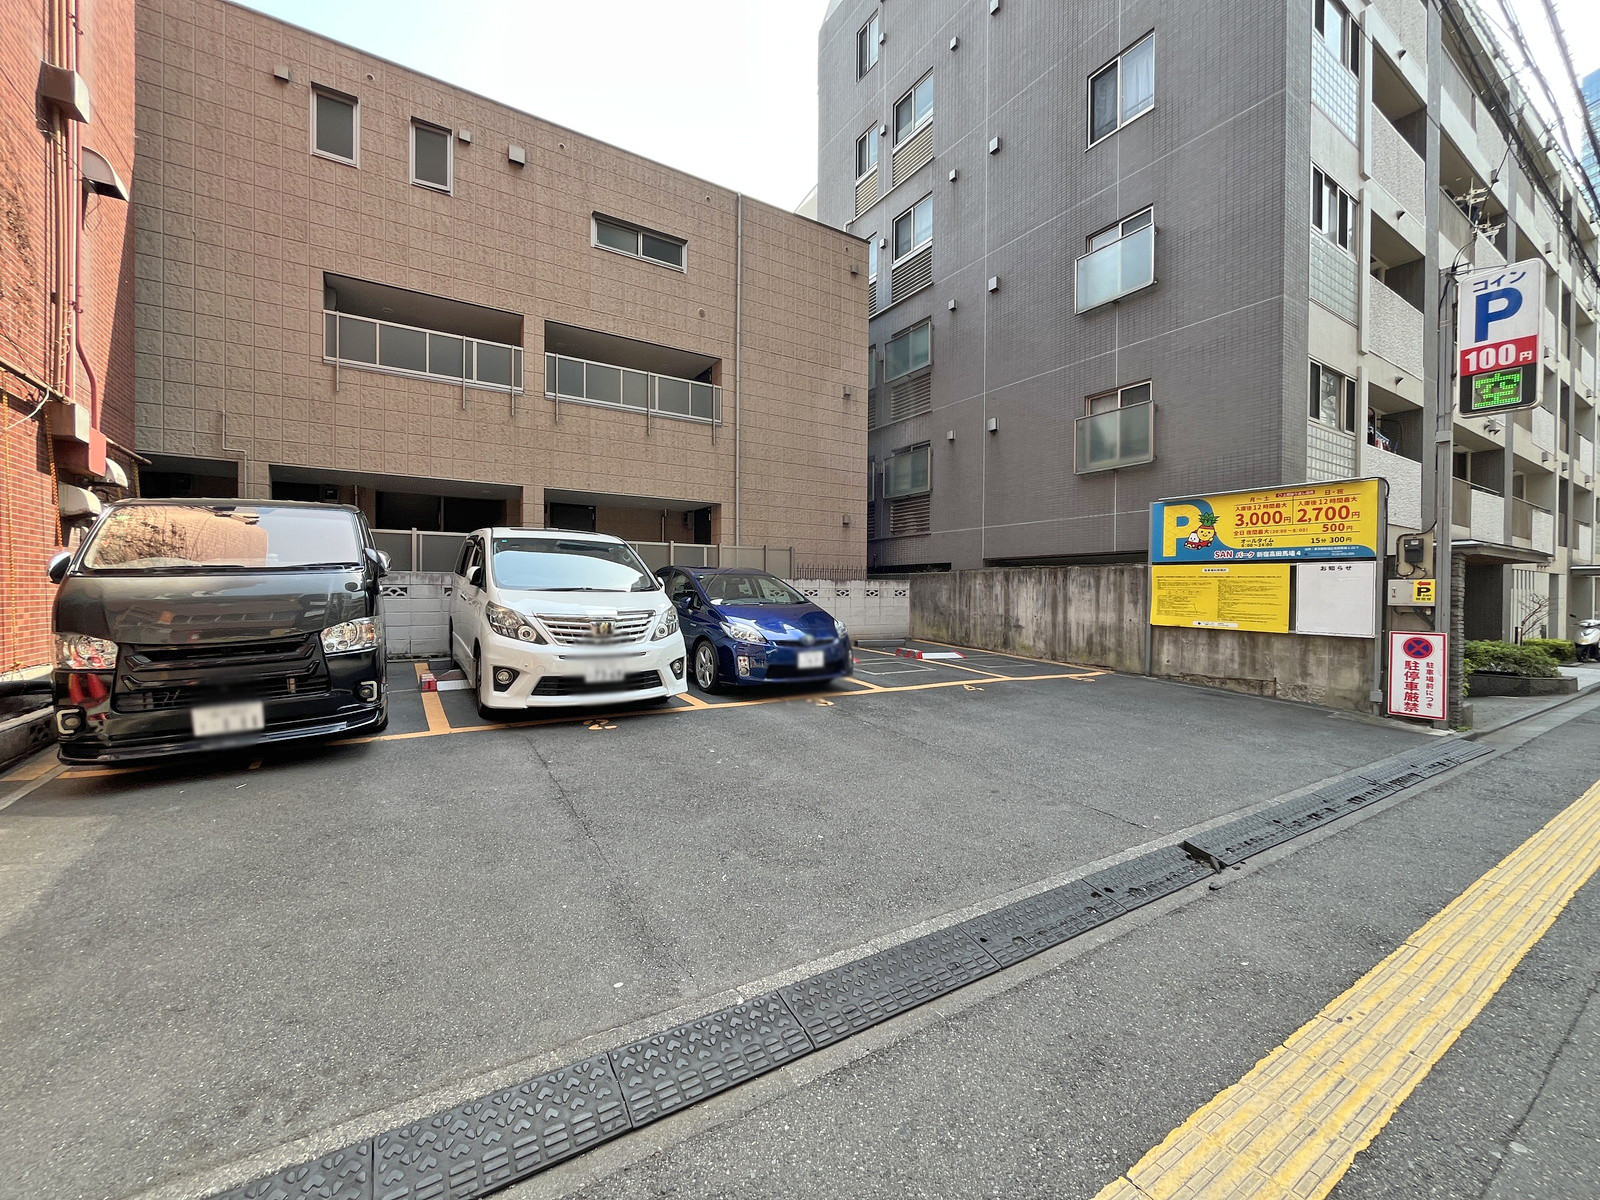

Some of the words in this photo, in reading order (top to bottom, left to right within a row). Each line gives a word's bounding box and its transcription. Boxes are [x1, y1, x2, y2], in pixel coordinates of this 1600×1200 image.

[1473, 271, 1527, 293] コイン
[1474, 287, 1523, 343] P
[1464, 343, 1533, 372] 100円
[1474, 372, 1521, 408] 空
[1163, 504, 1202, 557] P
[1213, 550, 1234, 559] SAN
[1416, 586, 1431, 597] P
[1403, 660, 1420, 713] 駐停車厳禁
